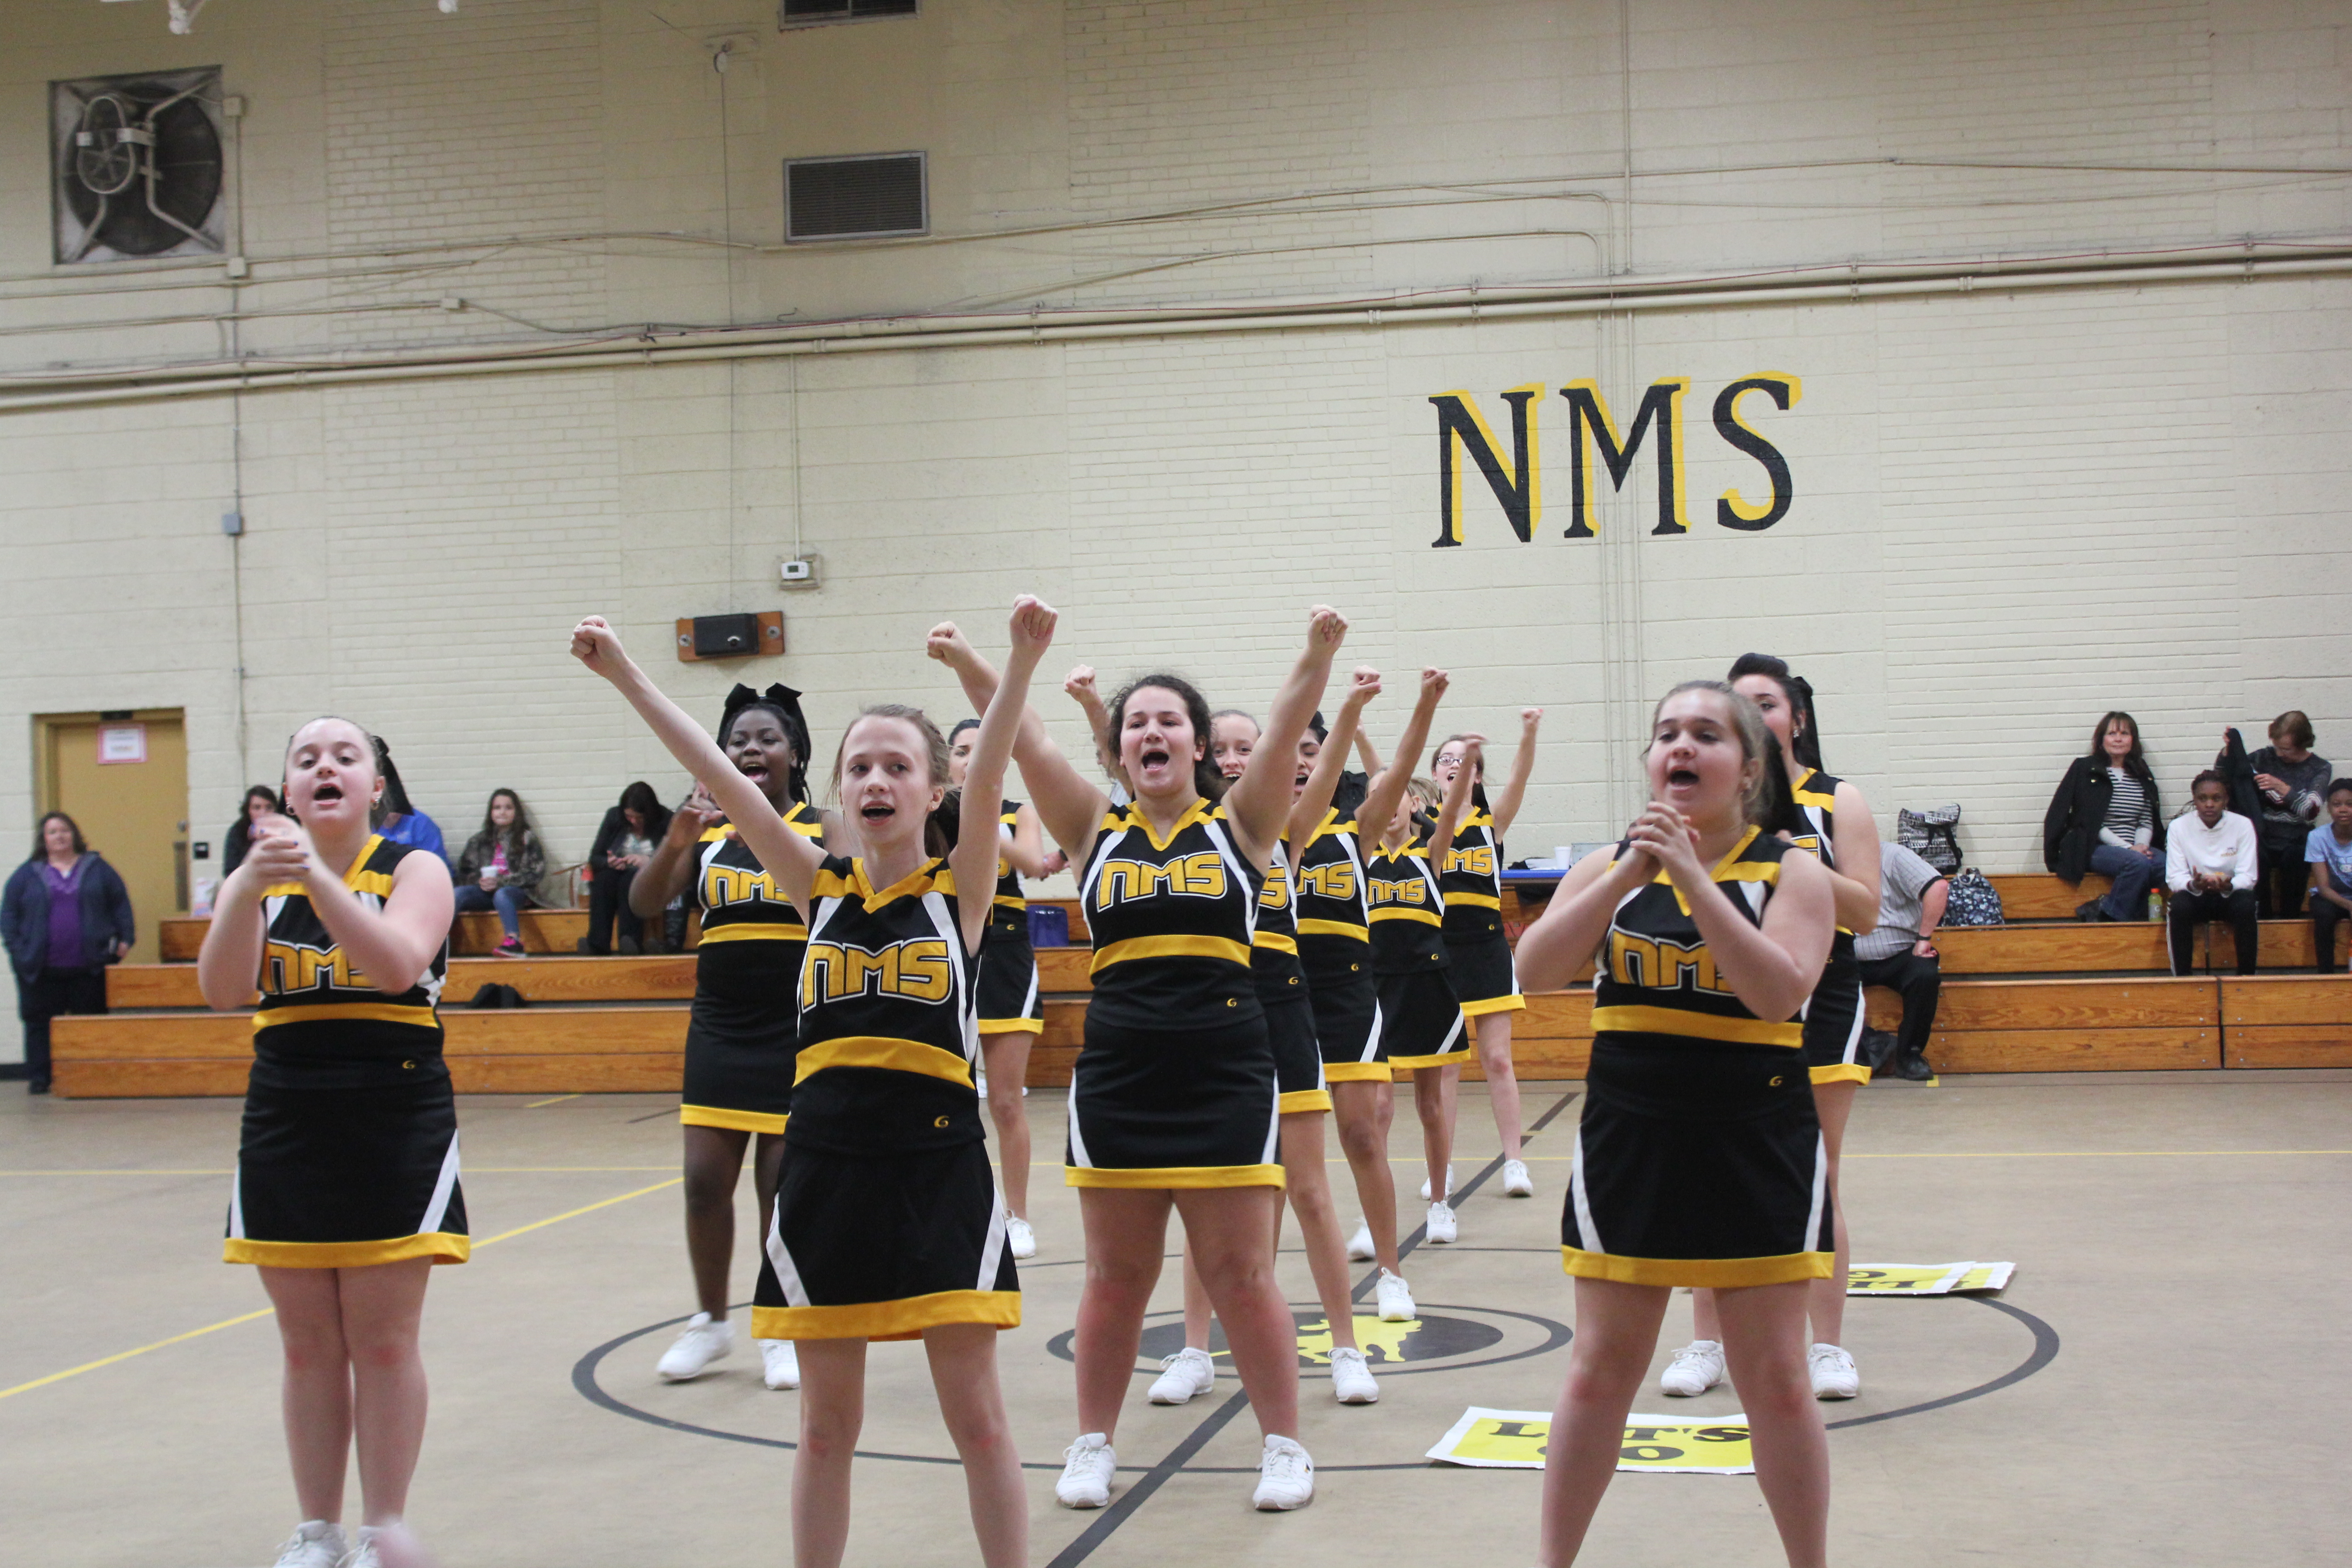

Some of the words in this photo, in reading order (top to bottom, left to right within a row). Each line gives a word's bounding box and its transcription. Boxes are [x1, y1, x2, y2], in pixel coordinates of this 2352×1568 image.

[1428, 370, 1802, 548] NMS
[705, 863, 794, 908] NM
[1097, 850, 1228, 913] NMS
[1296, 860, 1356, 901] MS
[1442, 845, 1494, 877] MS
[1367, 877, 1426, 906] NMS
[260, 938, 382, 995] NM
[800, 937, 953, 1014] NMS
[1609, 924, 1736, 996] NM
[1488, 1421, 1750, 1443] LT'S
